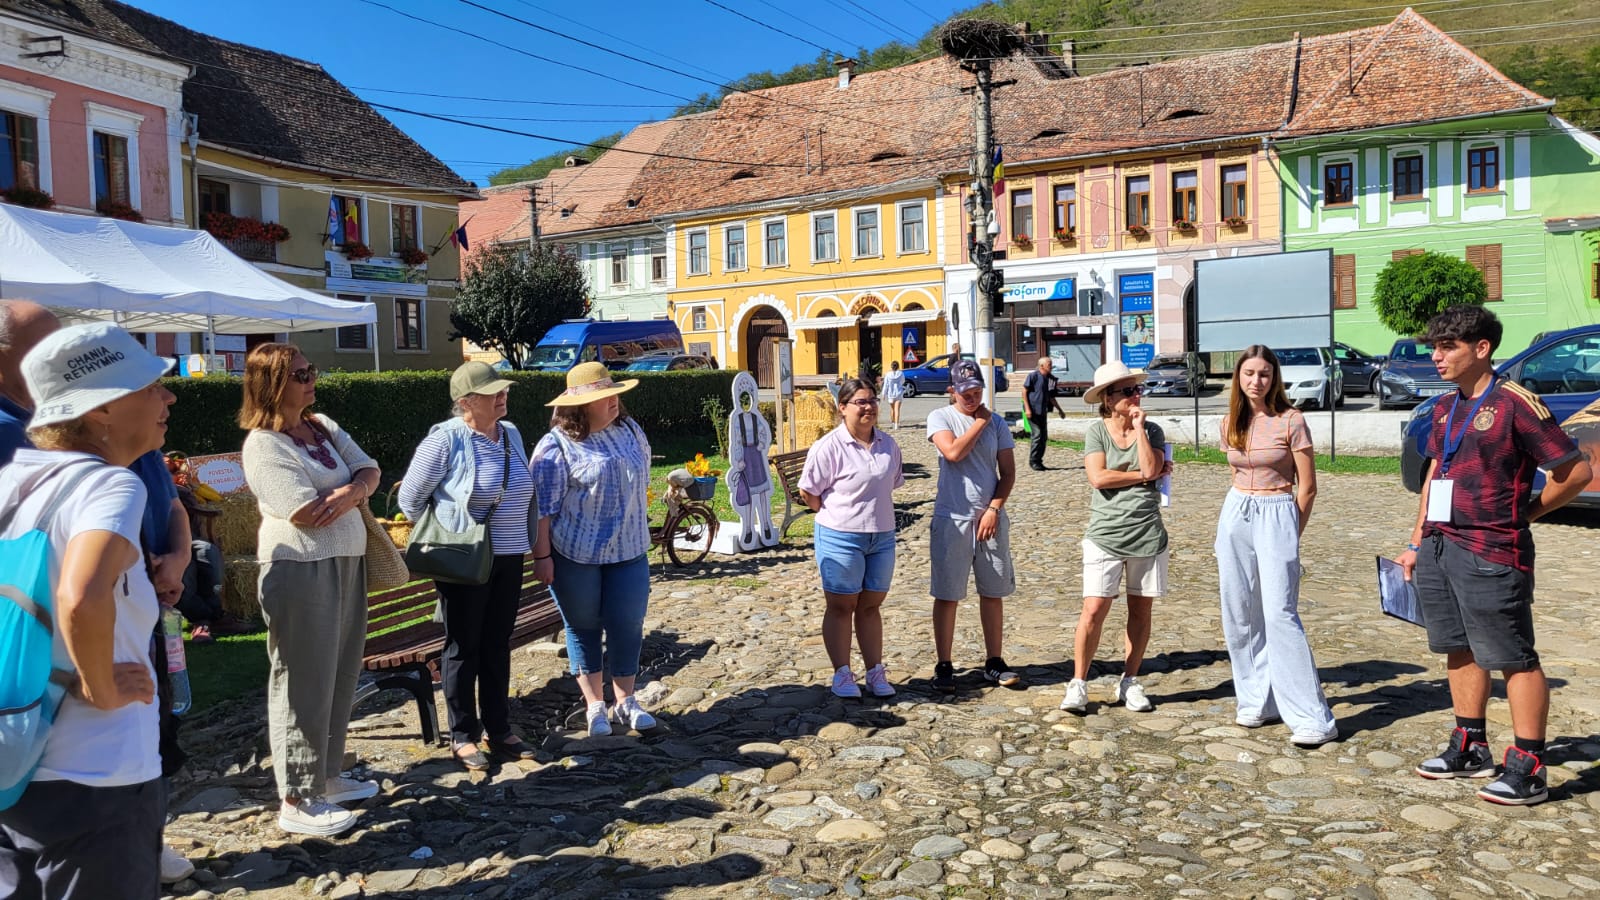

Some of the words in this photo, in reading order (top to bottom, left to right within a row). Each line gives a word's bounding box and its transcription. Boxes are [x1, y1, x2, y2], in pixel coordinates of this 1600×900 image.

[1003, 285, 1046, 299] vofarm
[63, 351, 125, 382] RETHYMNO
[67, 346, 110, 369] CHANIA
[36, 404, 74, 419] ETE
